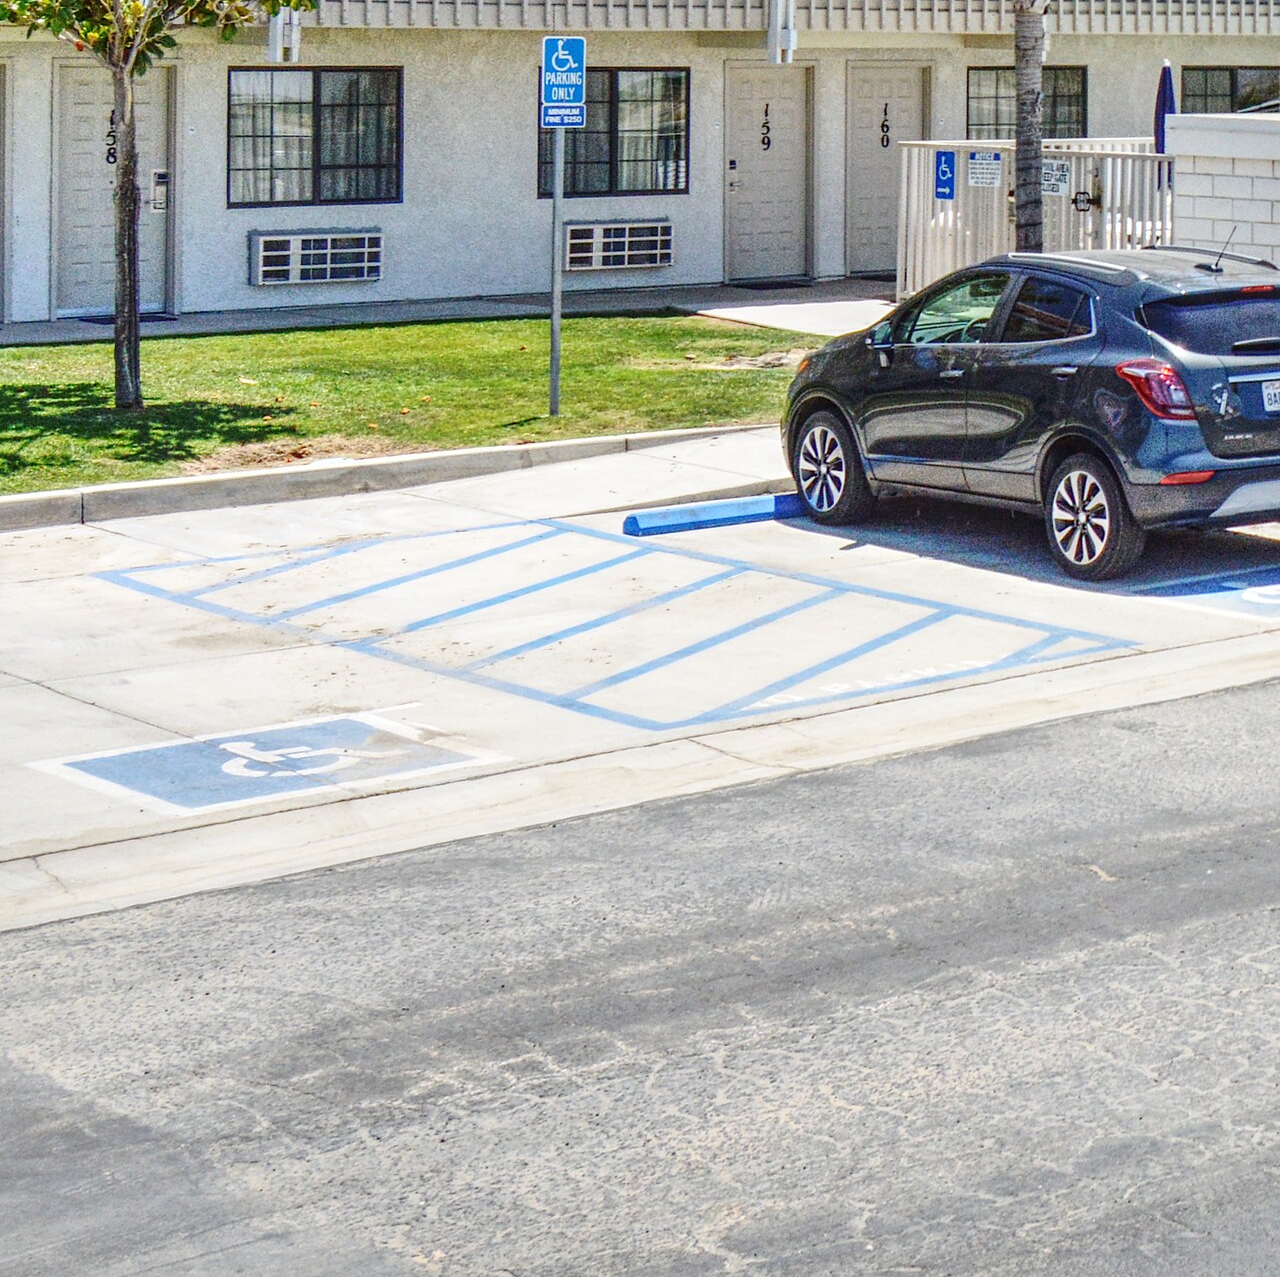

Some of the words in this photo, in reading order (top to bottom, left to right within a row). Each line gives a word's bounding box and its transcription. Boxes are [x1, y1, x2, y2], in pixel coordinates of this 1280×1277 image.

[545, 72, 582, 85] PARKING
[552, 87, 575, 100] ONLY
[545, 116, 561, 124] FINE
[563, 116, 583, 124] $250
[761, 103, 771, 151] 159
[881, 103, 889, 148] 160
[106, 109, 117, 164] 158
